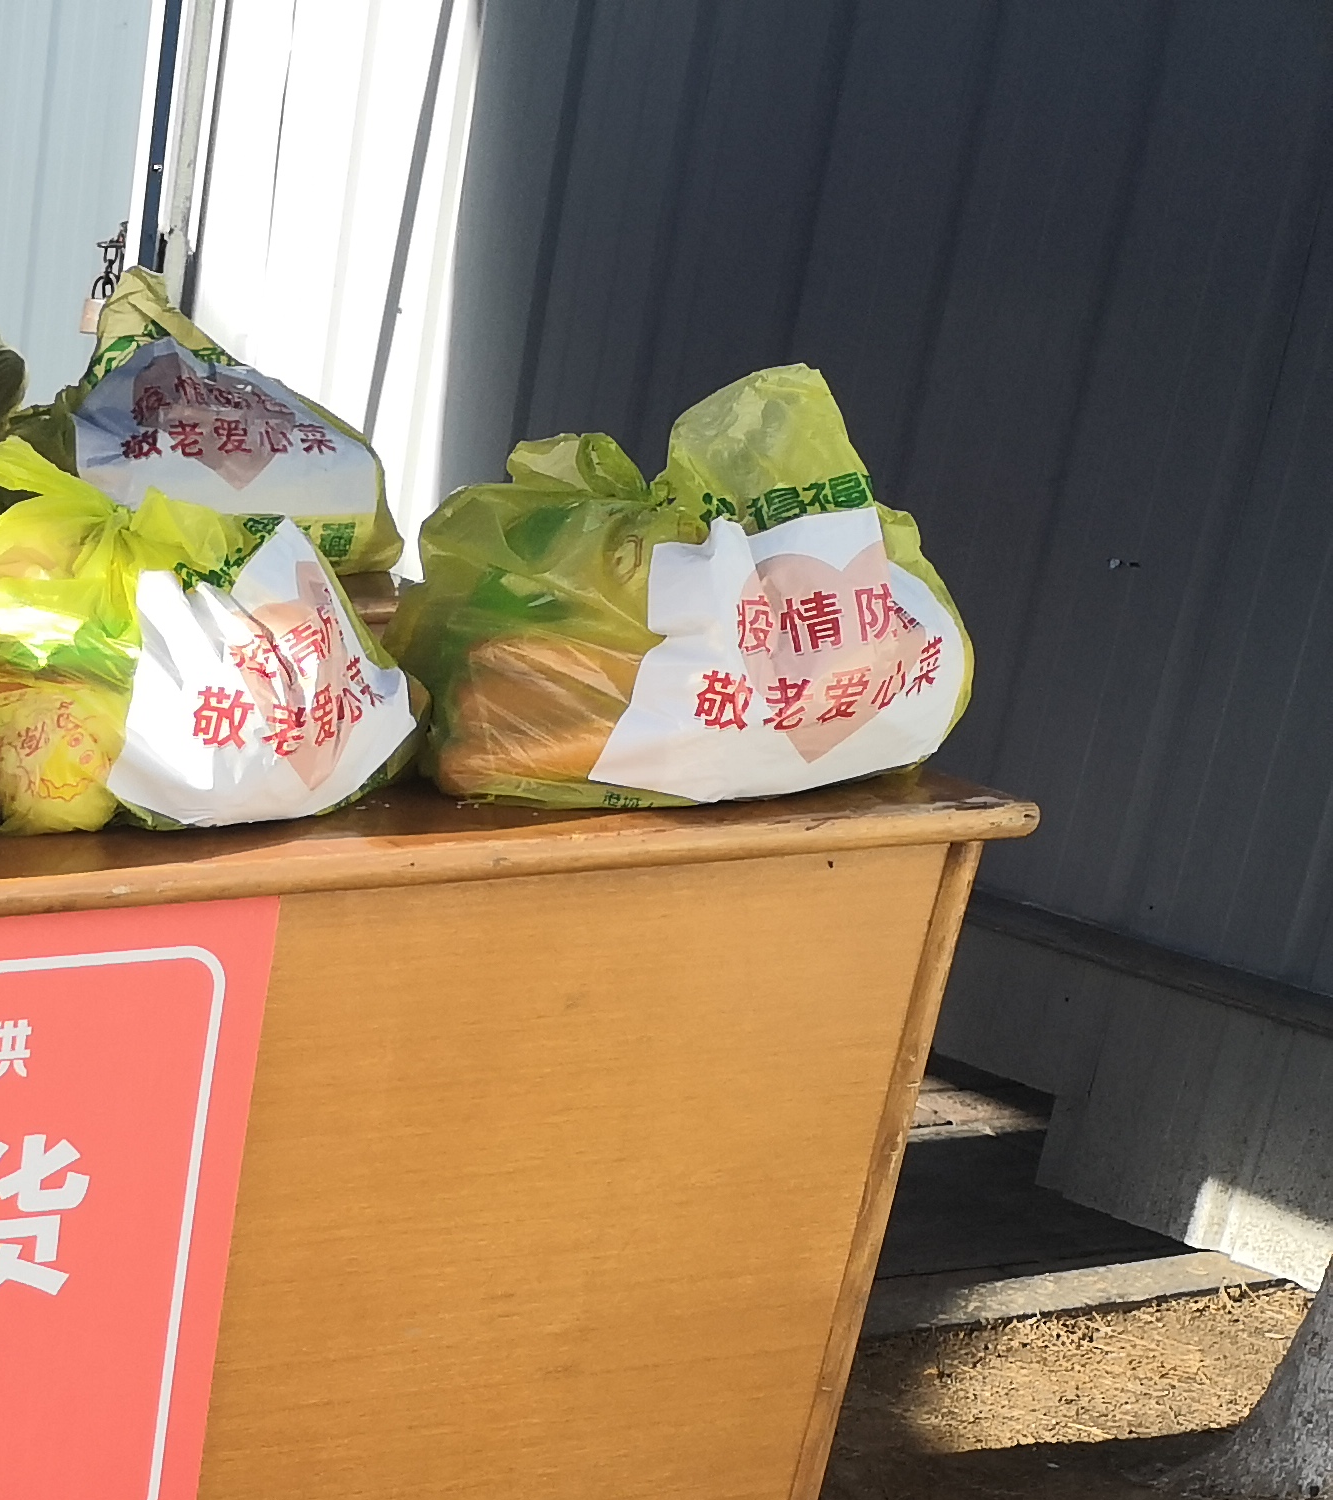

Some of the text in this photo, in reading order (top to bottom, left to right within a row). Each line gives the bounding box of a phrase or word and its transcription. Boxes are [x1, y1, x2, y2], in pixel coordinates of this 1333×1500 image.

[120, 417, 338, 460] 敬老爱心菜
[192, 654, 385, 757] 敬老爱心菜
[693, 635, 944, 732] 敬老爱心菜
